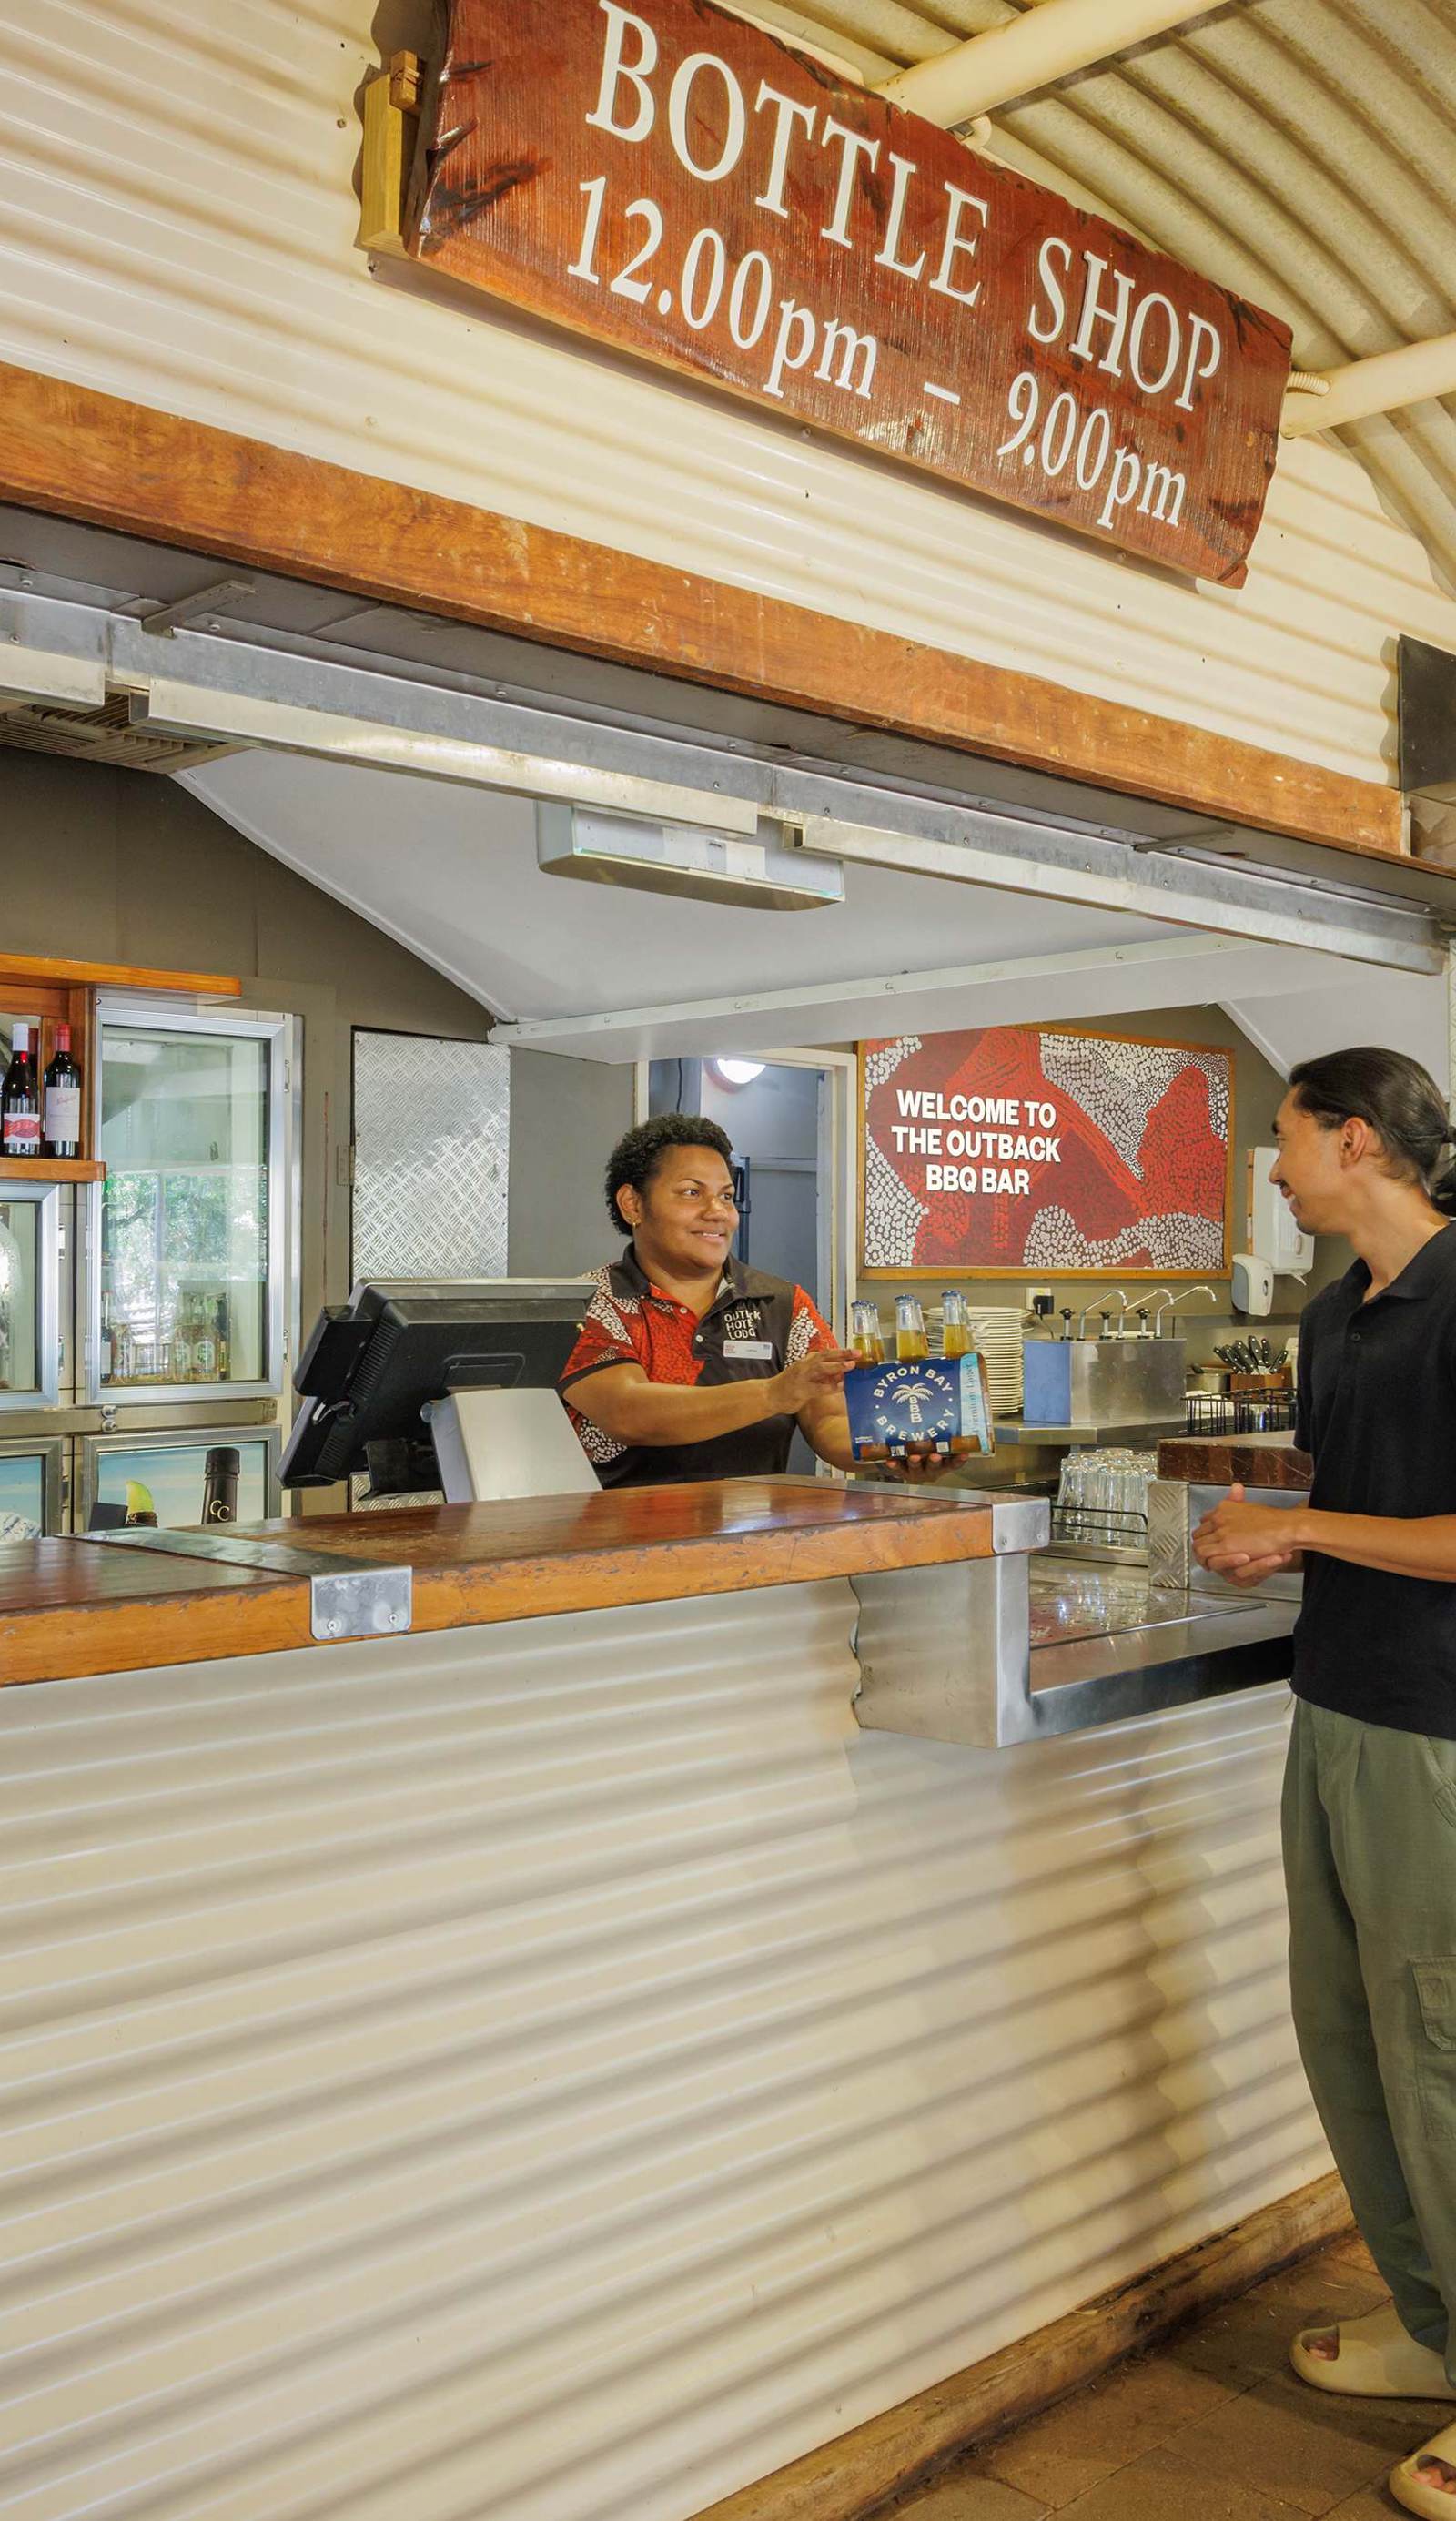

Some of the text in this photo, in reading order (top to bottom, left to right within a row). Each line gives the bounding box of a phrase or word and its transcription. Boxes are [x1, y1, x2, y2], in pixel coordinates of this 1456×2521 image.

[585, 0, 1221, 412] BOTTLE SHOP
[567, 176, 879, 400] 12.00pm
[996, 371, 1188, 529] 9.00pm
[896, 1089, 1057, 1129] WELCOME TO
[891, 1125, 1061, 1163] THE OUTBACK
[926, 1164, 1030, 1195] BBQ BAR
[874, 1366, 954, 1398] BYRON BAY
[876, 1408, 955, 1442] BREWERY
